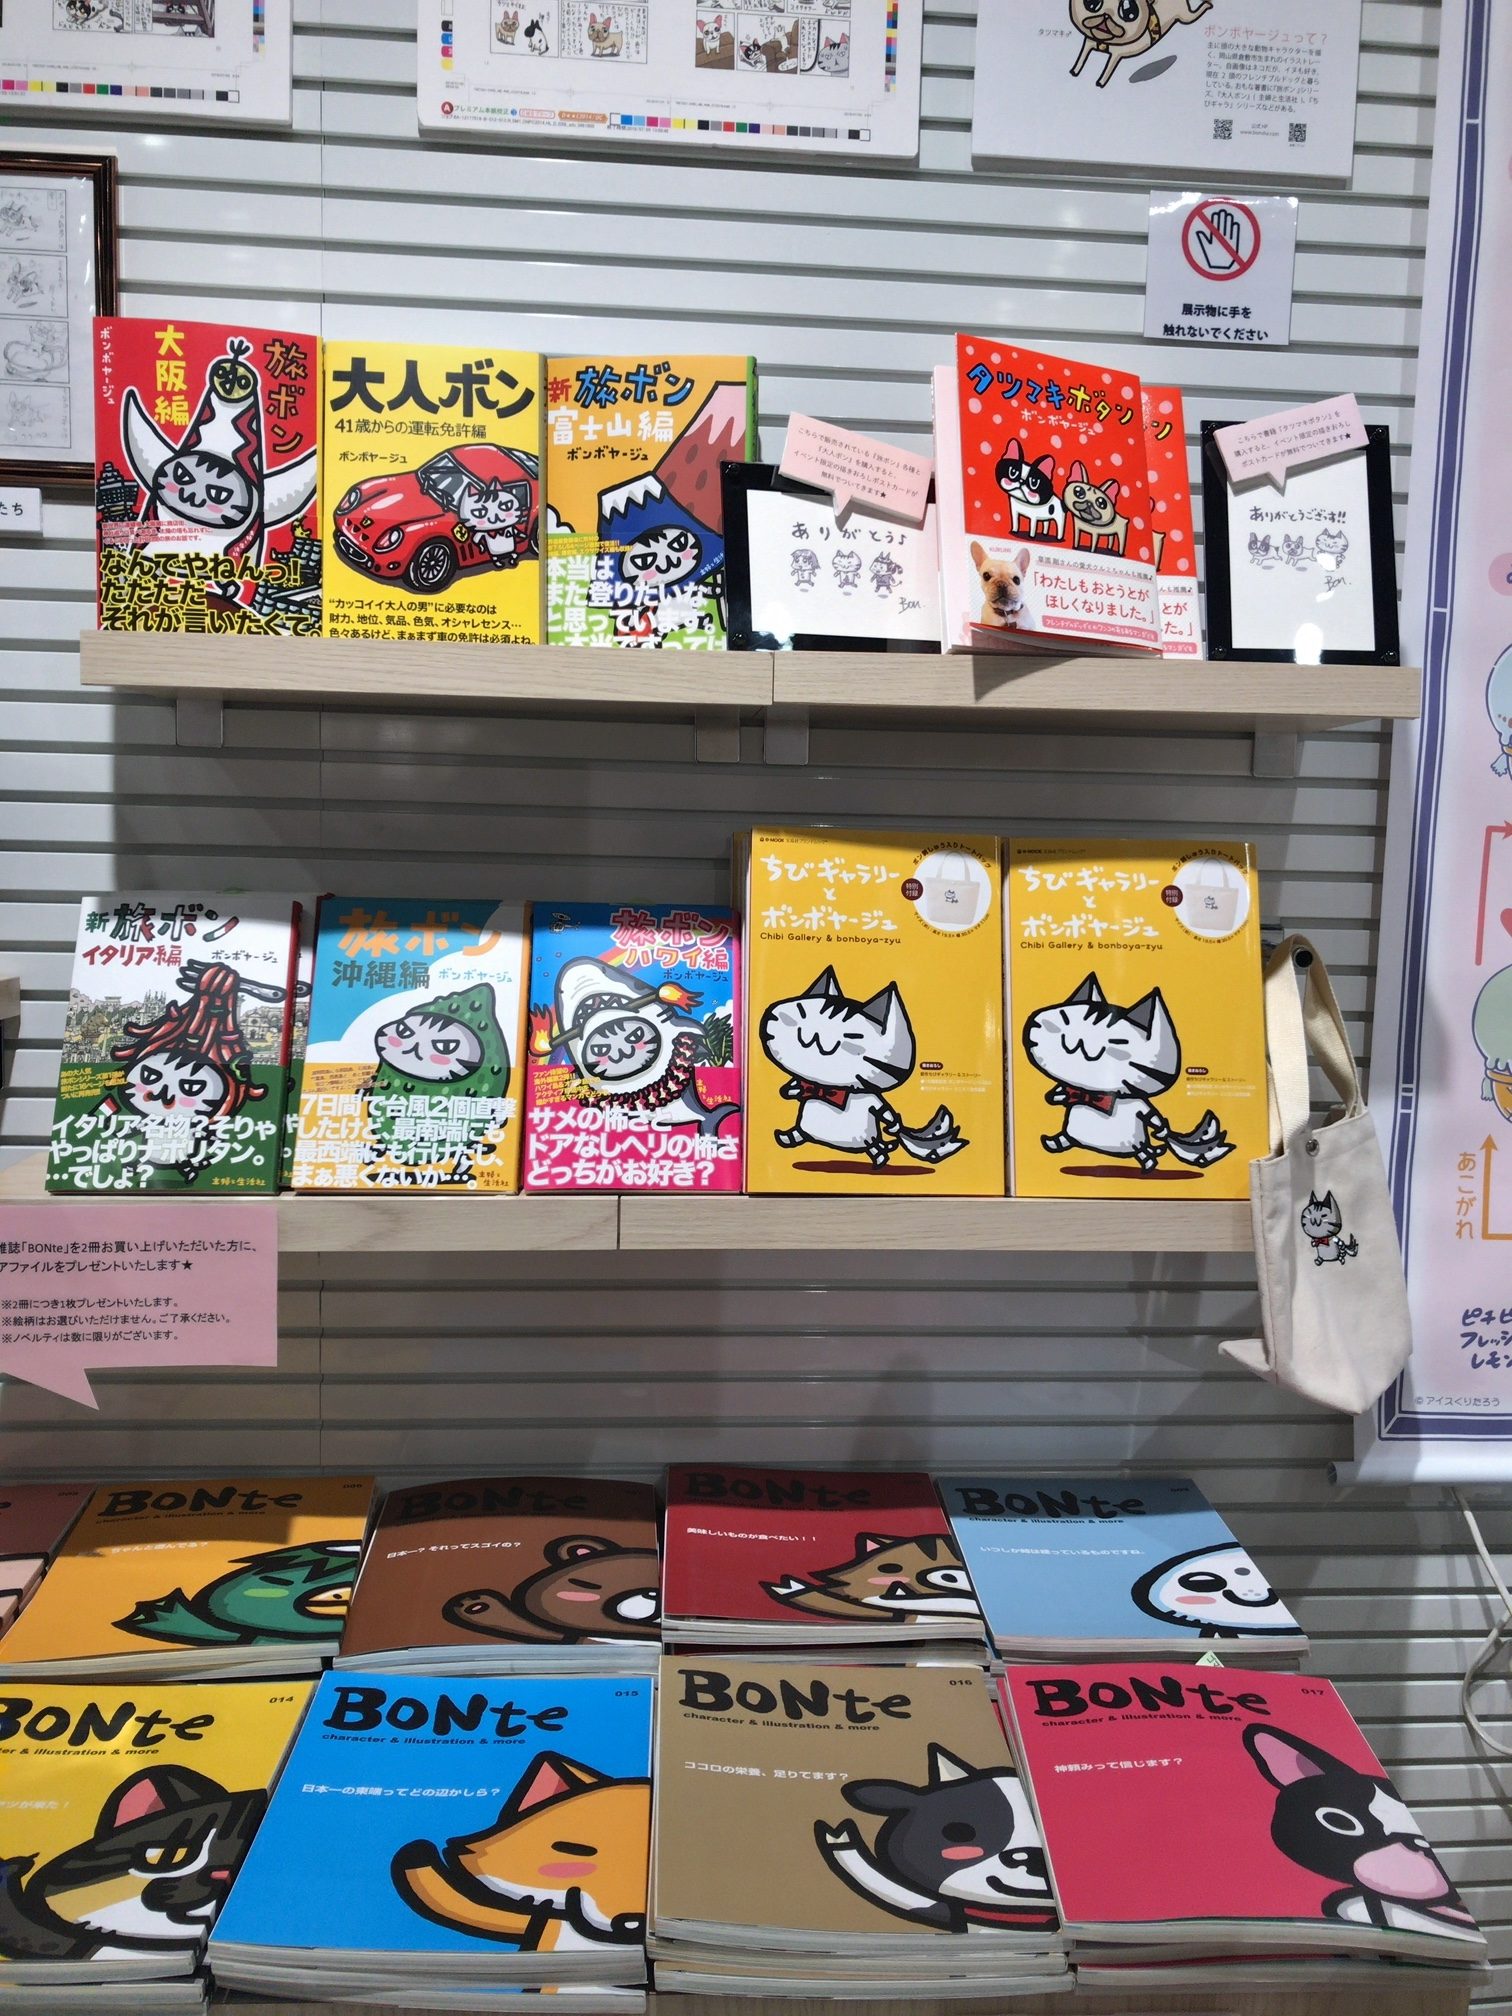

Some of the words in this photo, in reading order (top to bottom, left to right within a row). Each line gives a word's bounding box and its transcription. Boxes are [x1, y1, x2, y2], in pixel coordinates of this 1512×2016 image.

[1181, 303, 1252, 319] 展示物に手を
[1162, 323, 1269, 341] 触れないでください
[100, 326, 115, 405] ボンボヤージュ
[153, 324, 190, 426] 大阪編
[263, 338, 308, 453] 旅ボン
[330, 357, 535, 419] 大人ボン
[548, 376, 572, 403] 新
[574, 361, 695, 409] 旅ボン
[966, 362, 1134, 425] タツマキボタン
[334, 418, 487, 440] 41歳からの運転免許編
[548, 405, 674, 445] 富士山編
[1020, 408, 1097, 436] ボンボヤージュ
[338, 451, 408, 464] ボンボヤージュ
[567, 446, 649, 462] ボンボヤージュ
[547, 555, 614, 580] 本当は
[100, 577, 207, 606] ただただ
[547, 580, 709, 610] また登りたいな
[1033, 571, 1089, 594] 「わたしも
[1091, 581, 1149, 602] おとうとが
[100, 605, 323, 638] それが言いたくて。
[547, 606, 715, 635] と思っています。
[1045, 594, 1156, 624] ほしくなりました。」
[760, 853, 900, 885] ちびギャラリー
[1018, 864, 1160, 891] ちびギャラリー
[823, 887, 837, 901] と
[1082, 895, 1096, 908] と
[84, 910, 109, 934] 新
[110, 902, 240, 943] 旅ボン
[611, 907, 730, 949] 旅ボン
[761, 904, 898, 931] ボンボヤージュ
[1020, 913, 1159, 938] ボンボヤージュ
[337, 907, 503, 958] 旅ボン
[760, 932, 784, 941] Chibi
[788, 933, 822, 944] Gallery
[826, 934, 833, 943] &
[836, 934, 901, 944] bonboya-zyu
[1020, 941, 1044, 949] Chibi
[1048, 941, 1083, 951] Gallery
[1097, 942, 1163, 951] bonboya-zyu
[82, 944, 183, 967] イタリア編
[211, 950, 279, 964] ボンボヤージュ
[623, 946, 731, 971] ハワイ編
[331, 960, 431, 990] 沖縄編
[438, 967, 513, 984] ボンボヤージュ
[662, 967, 729, 983] ボンボヤージュ
[298, 1117, 506, 1144] したけど、最南端にも
[528, 1106, 672, 1133] サメの怖さと
[50, 1139, 266, 1167] やっぱりナポリタン。
[294, 1139, 505, 1168] 最西端にも行けたし、
[528, 1132, 740, 1161] ドアなしヘリの怖さ
[1455, 1151, 1477, 1241] あこがれ
[1, 1296, 180, 1310] ※2冊につき1枚プレゼントいたします。
[1, 1312, 231, 1327] ※絵柄はお選びいただけません。ご了承ください。
[1, 1329, 180, 1344] ※ノベルティは数に限りがございます。
[97, 1486, 303, 1518] BONte
[955, 1487, 1146, 1519] BONte
[686, 1527, 817, 1543] 美味しいものが食べたい！！
[269, 1696, 294, 1704] 014
[677, 1668, 912, 1724] BONte
[1025, 1675, 1271, 1717] BONte
[1301, 1688, 1325, 1696] 017
[323, 1686, 569, 1738] BONte
[683, 1711, 745, 1725] character
[762, 1719, 831, 1730] illustration
[848, 1723, 881, 1731] more
[1041, 1717, 1104, 1727] character
[1121, 1712, 1191, 1721] illustration
[1209, 1714, 1243, 1722] more
[34, 1748, 106, 1756] illustration
[322, 1732, 387, 1743] character
[404, 1736, 475, 1746] illustration
[684, 1760, 849, 1781] ココロの栄養、足りてます？
[1054, 1757, 1184, 1773] 神頼みって信じます？
